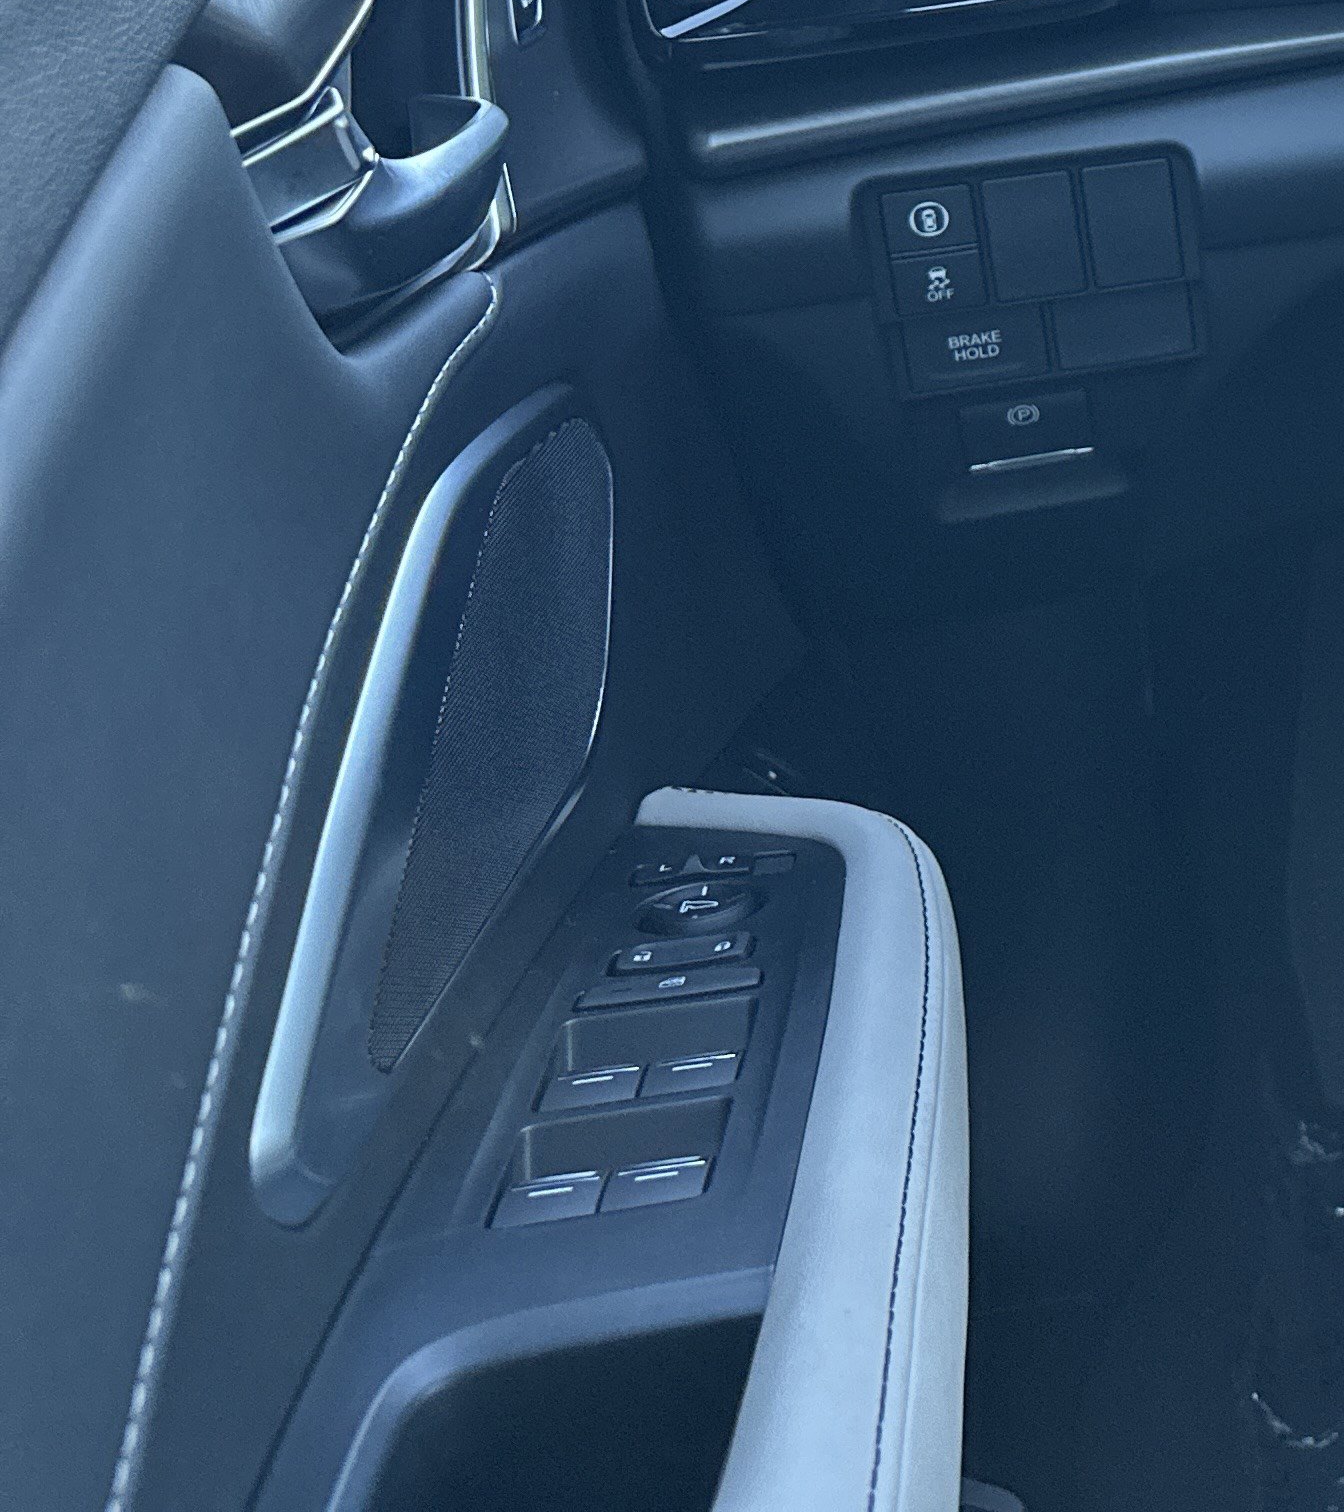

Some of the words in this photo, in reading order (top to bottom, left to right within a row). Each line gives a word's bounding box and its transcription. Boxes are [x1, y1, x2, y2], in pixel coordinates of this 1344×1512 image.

[927, 288, 954, 303] OFF
[947, 329, 1002, 351] BRAKE
[954, 343, 1000, 362] HOLD
